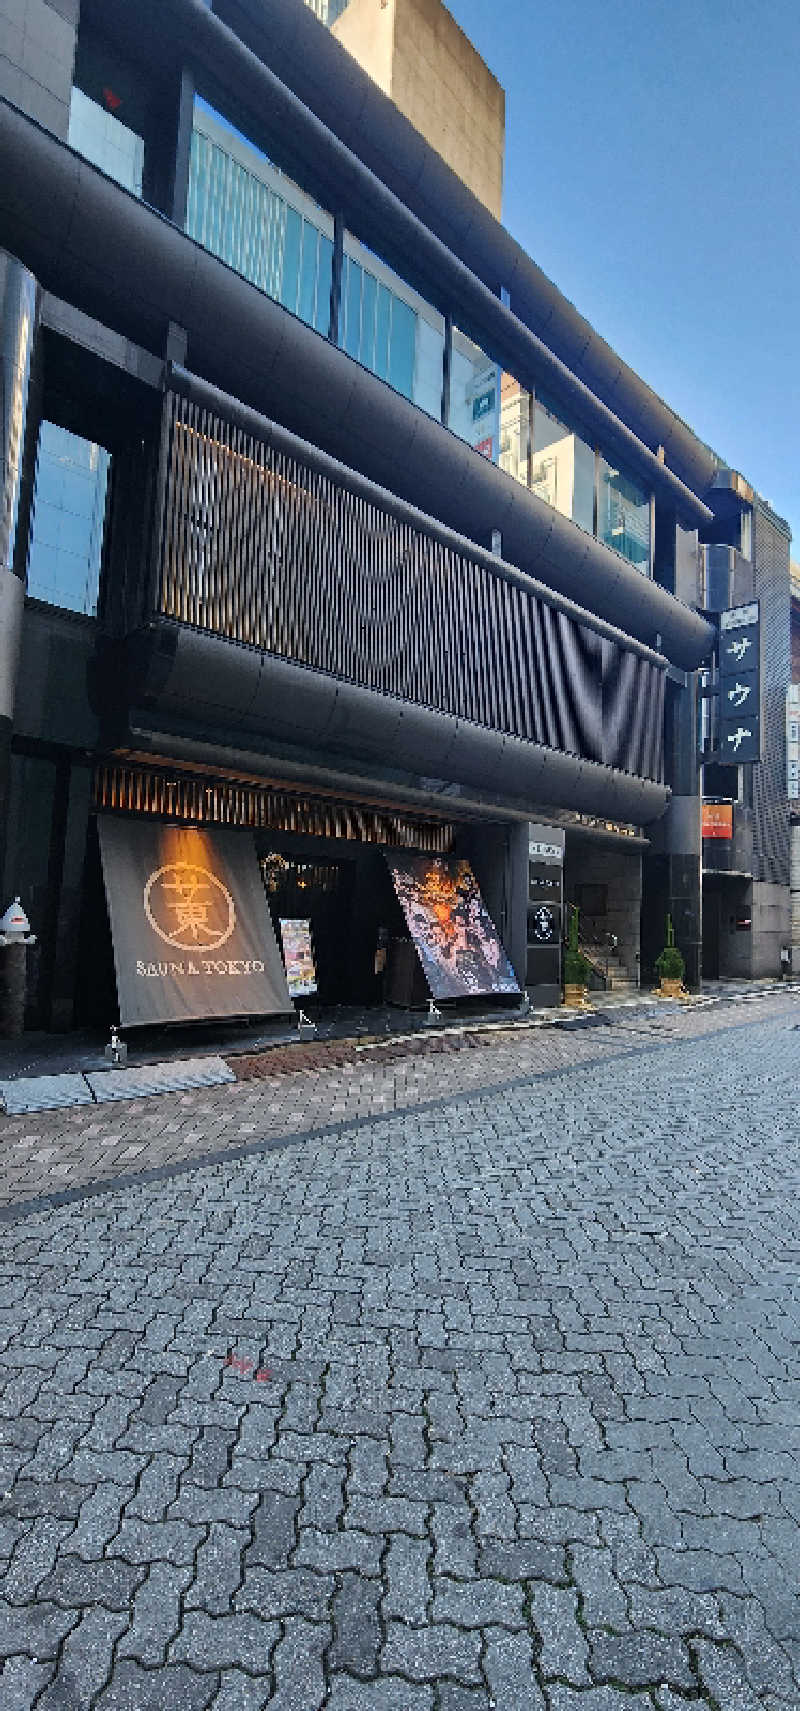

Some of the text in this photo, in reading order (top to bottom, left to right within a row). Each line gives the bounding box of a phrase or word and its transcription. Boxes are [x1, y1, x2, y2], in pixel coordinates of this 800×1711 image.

[726, 637, 752, 752] サウナ
[136, 960, 265, 977] SAUNA TOKYO
